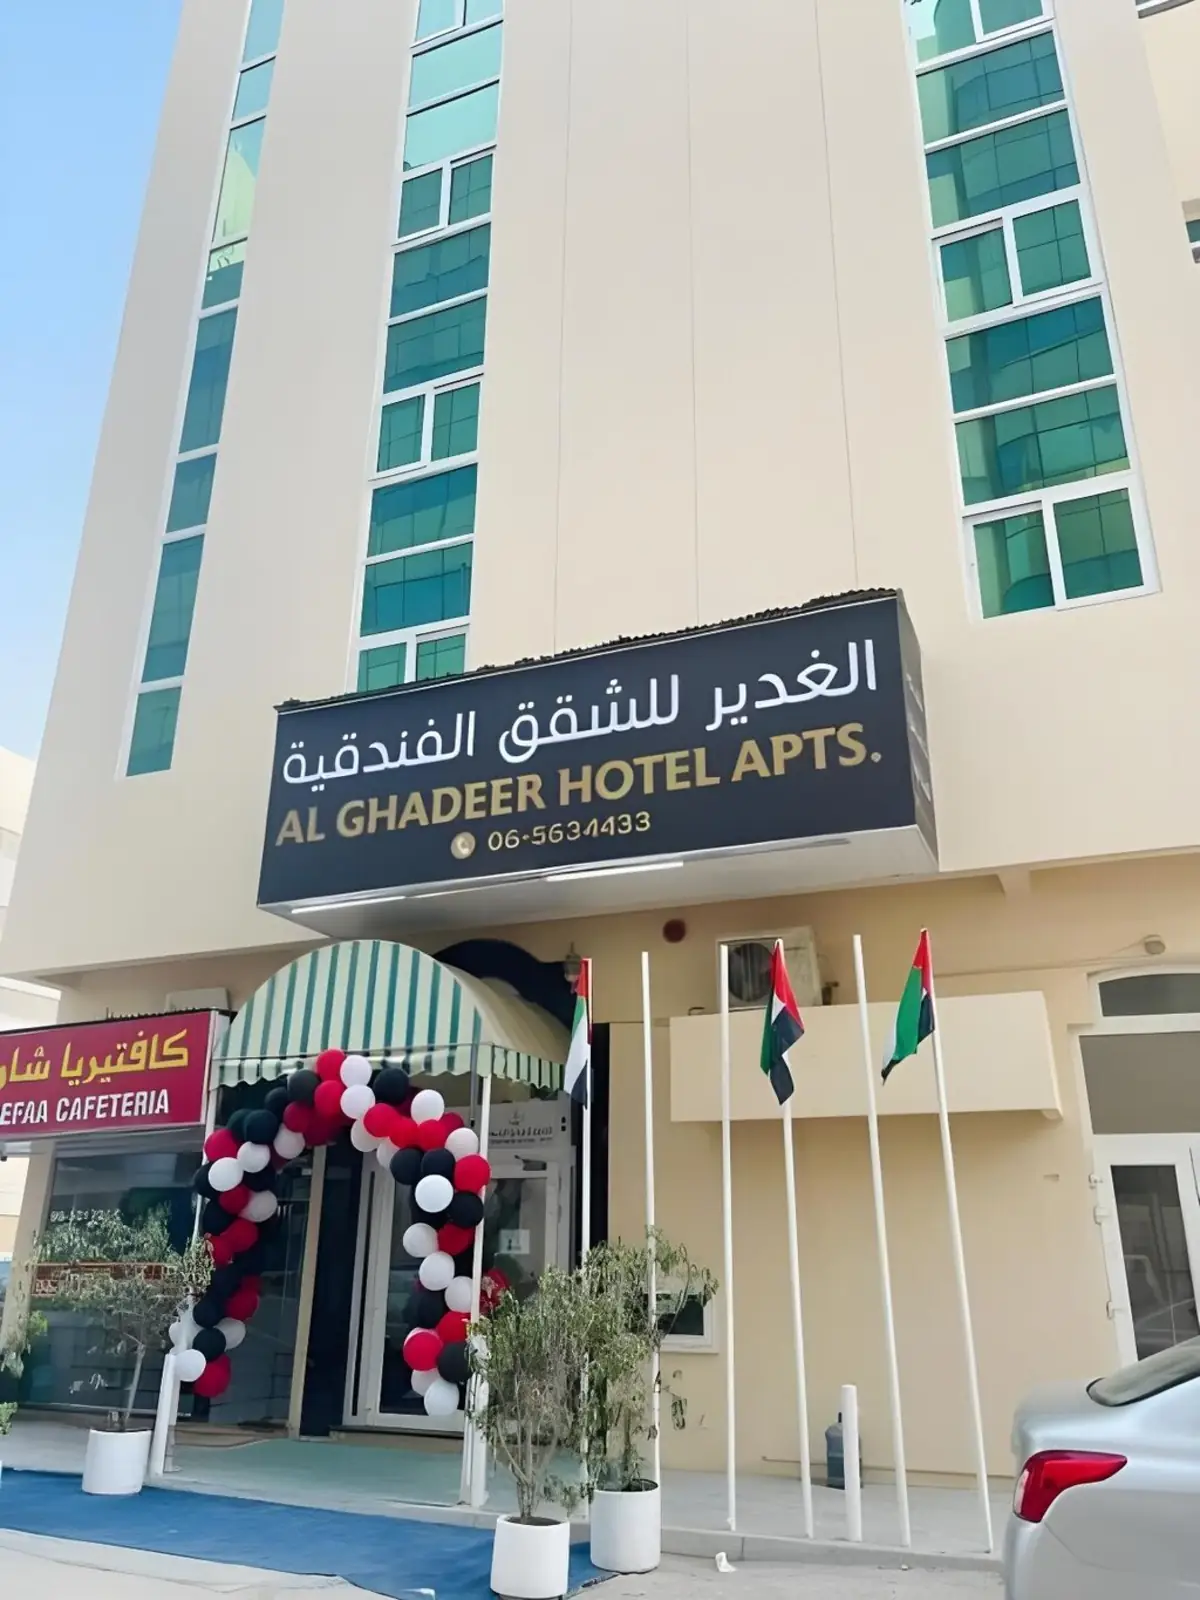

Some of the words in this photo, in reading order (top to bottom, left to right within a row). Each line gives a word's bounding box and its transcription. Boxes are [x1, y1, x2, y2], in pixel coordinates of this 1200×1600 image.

[499, 674, 679, 763] للشقق
[705, 639, 877, 731] الغدير
[275, 806, 325, 847] AL
[336, 773, 546, 838] GHADEER
[557, 747, 721, 806] HOTEL
[731, 722, 882, 782] APTS.
[283, 710, 476, 792] الفندقية
[60, 1028, 189, 1087] كافتيريا
[56, 1089, 170, 1123] CAFETERIA
